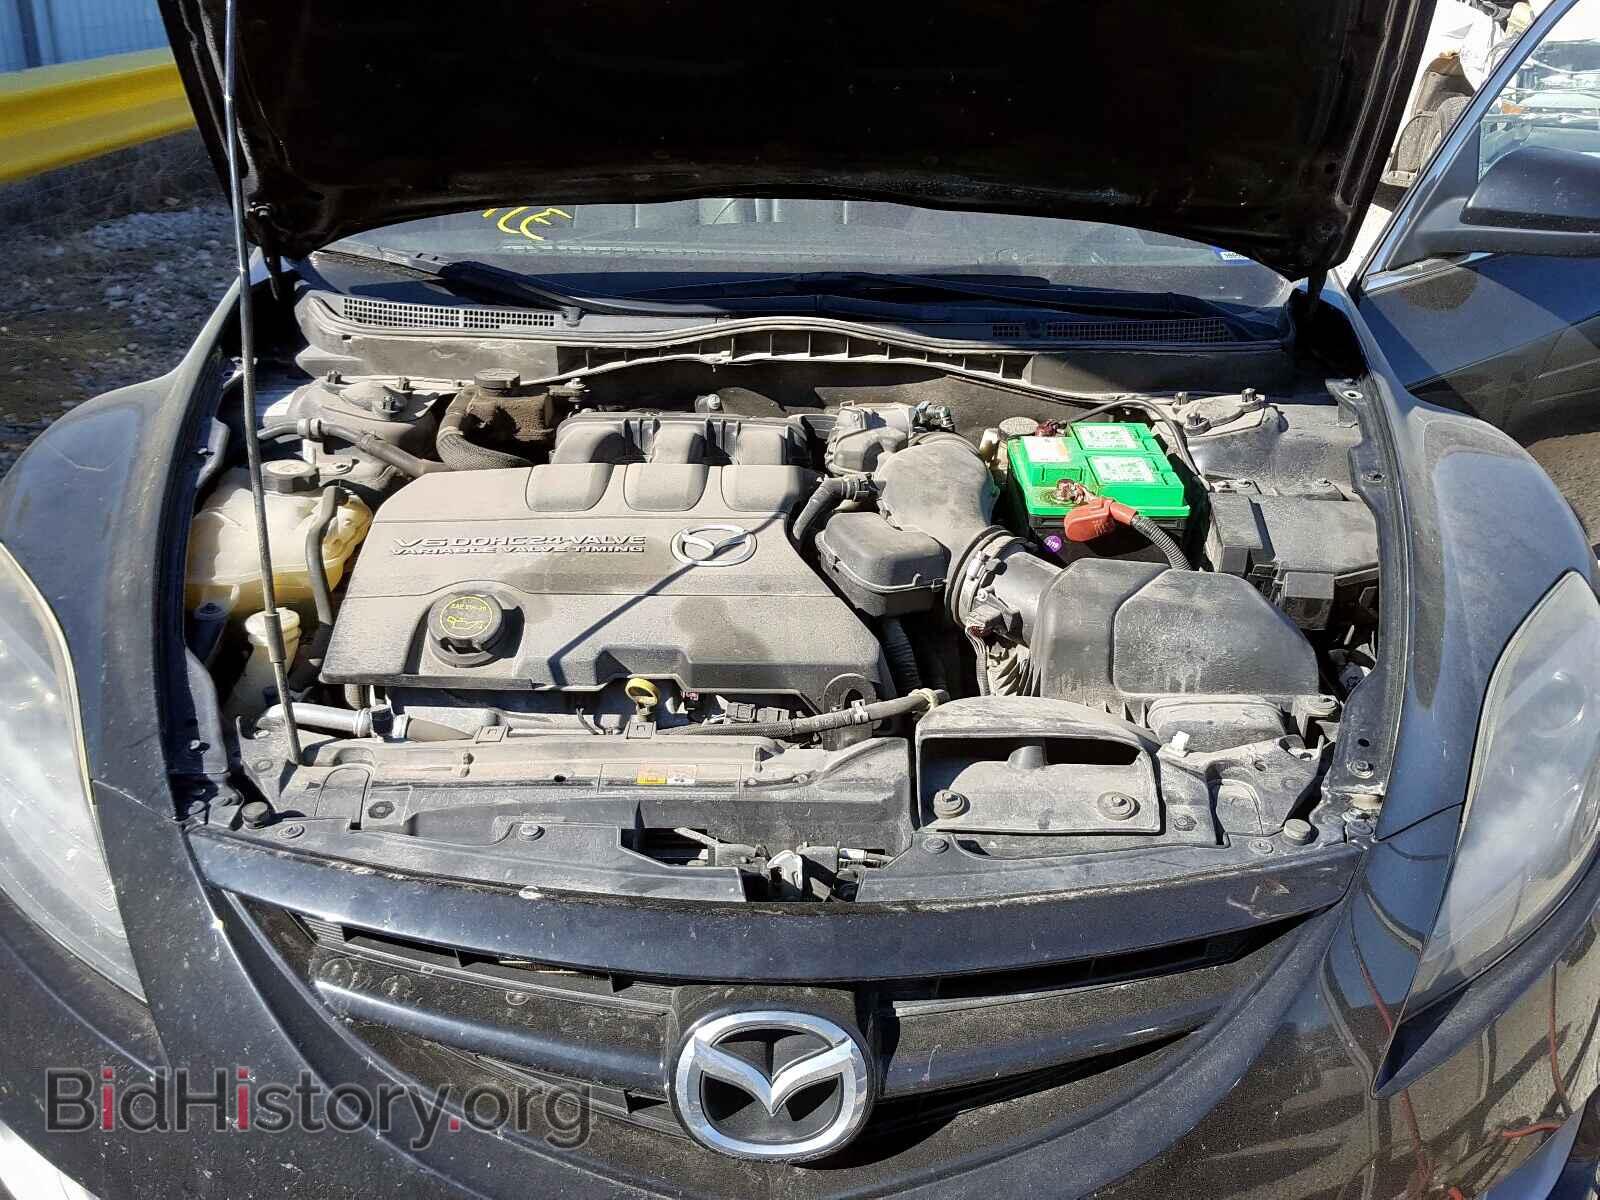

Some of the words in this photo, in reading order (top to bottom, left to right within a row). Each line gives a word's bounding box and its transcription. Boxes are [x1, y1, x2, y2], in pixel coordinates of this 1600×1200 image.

[392, 535, 448, 547] V6
[449, 535, 528, 546] DOHC
[391, 547, 498, 556] VARIABLE
[500, 545, 568, 553] VALVE
[574, 544, 645, 553] TIMING
